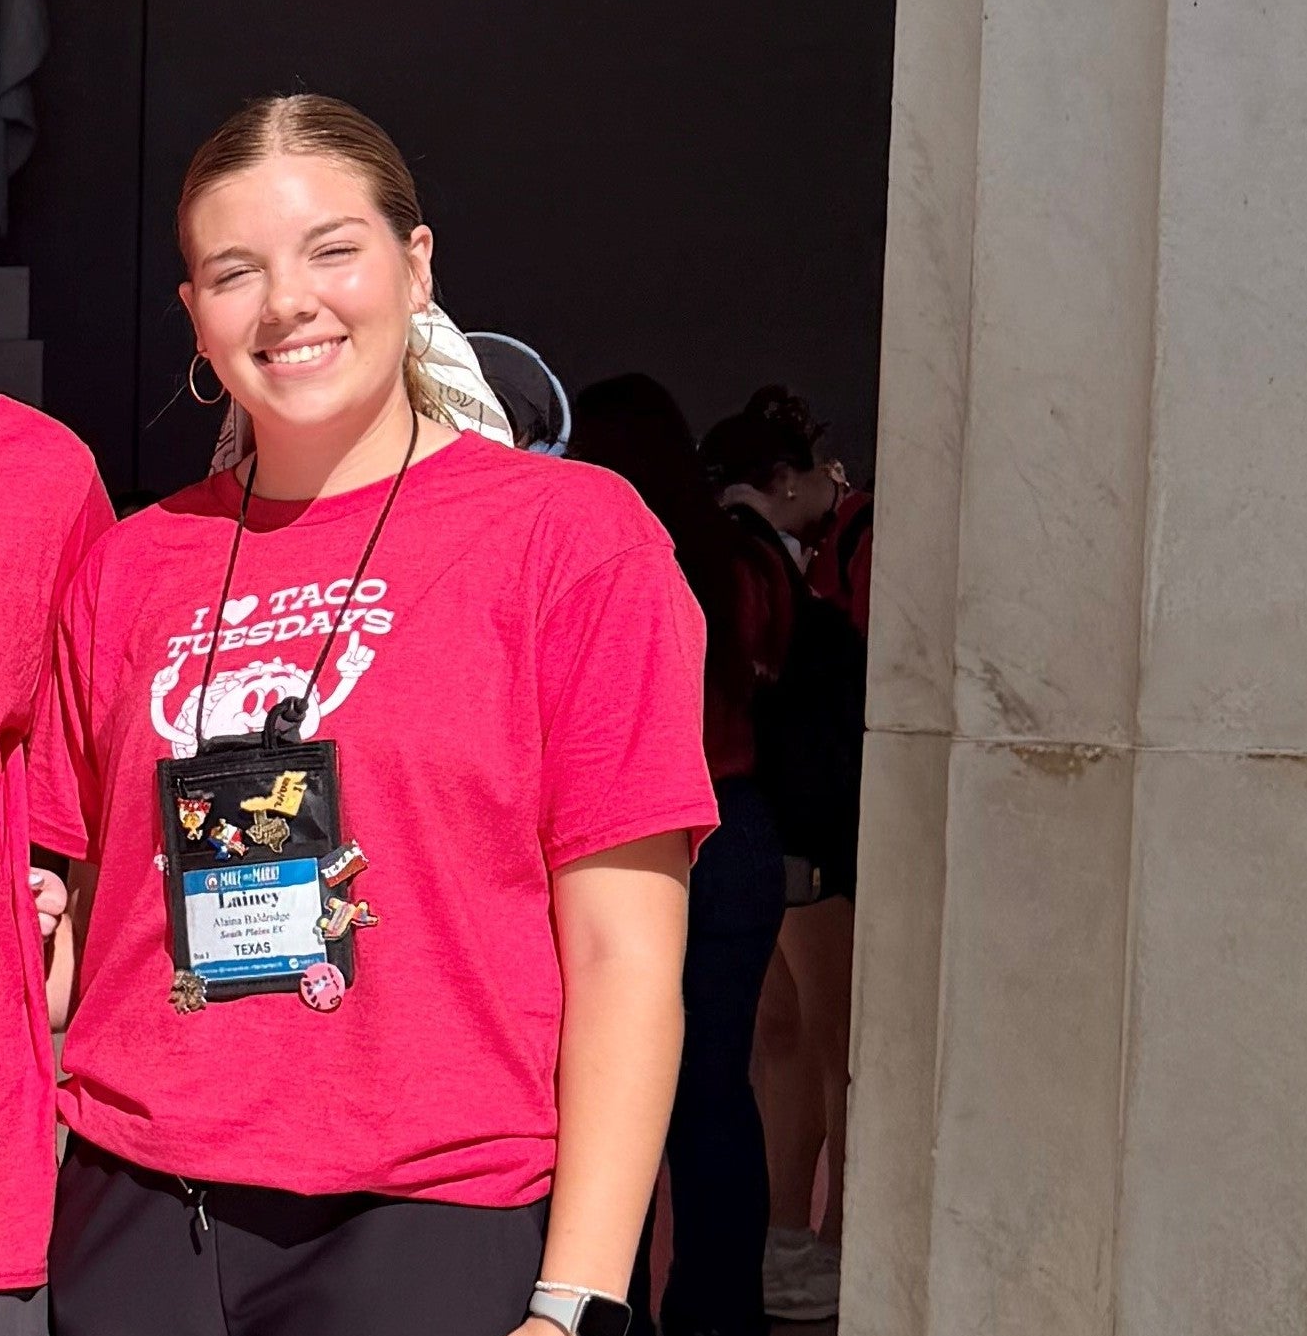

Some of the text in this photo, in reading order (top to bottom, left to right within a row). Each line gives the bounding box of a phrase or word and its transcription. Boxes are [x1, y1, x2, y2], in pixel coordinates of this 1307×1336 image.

[192, 579, 388, 630] I TACO
[168, 609, 394, 658] TUESDAYS
[218, 891, 281, 909] Lainey
[233, 941, 271, 956] TEXAS
